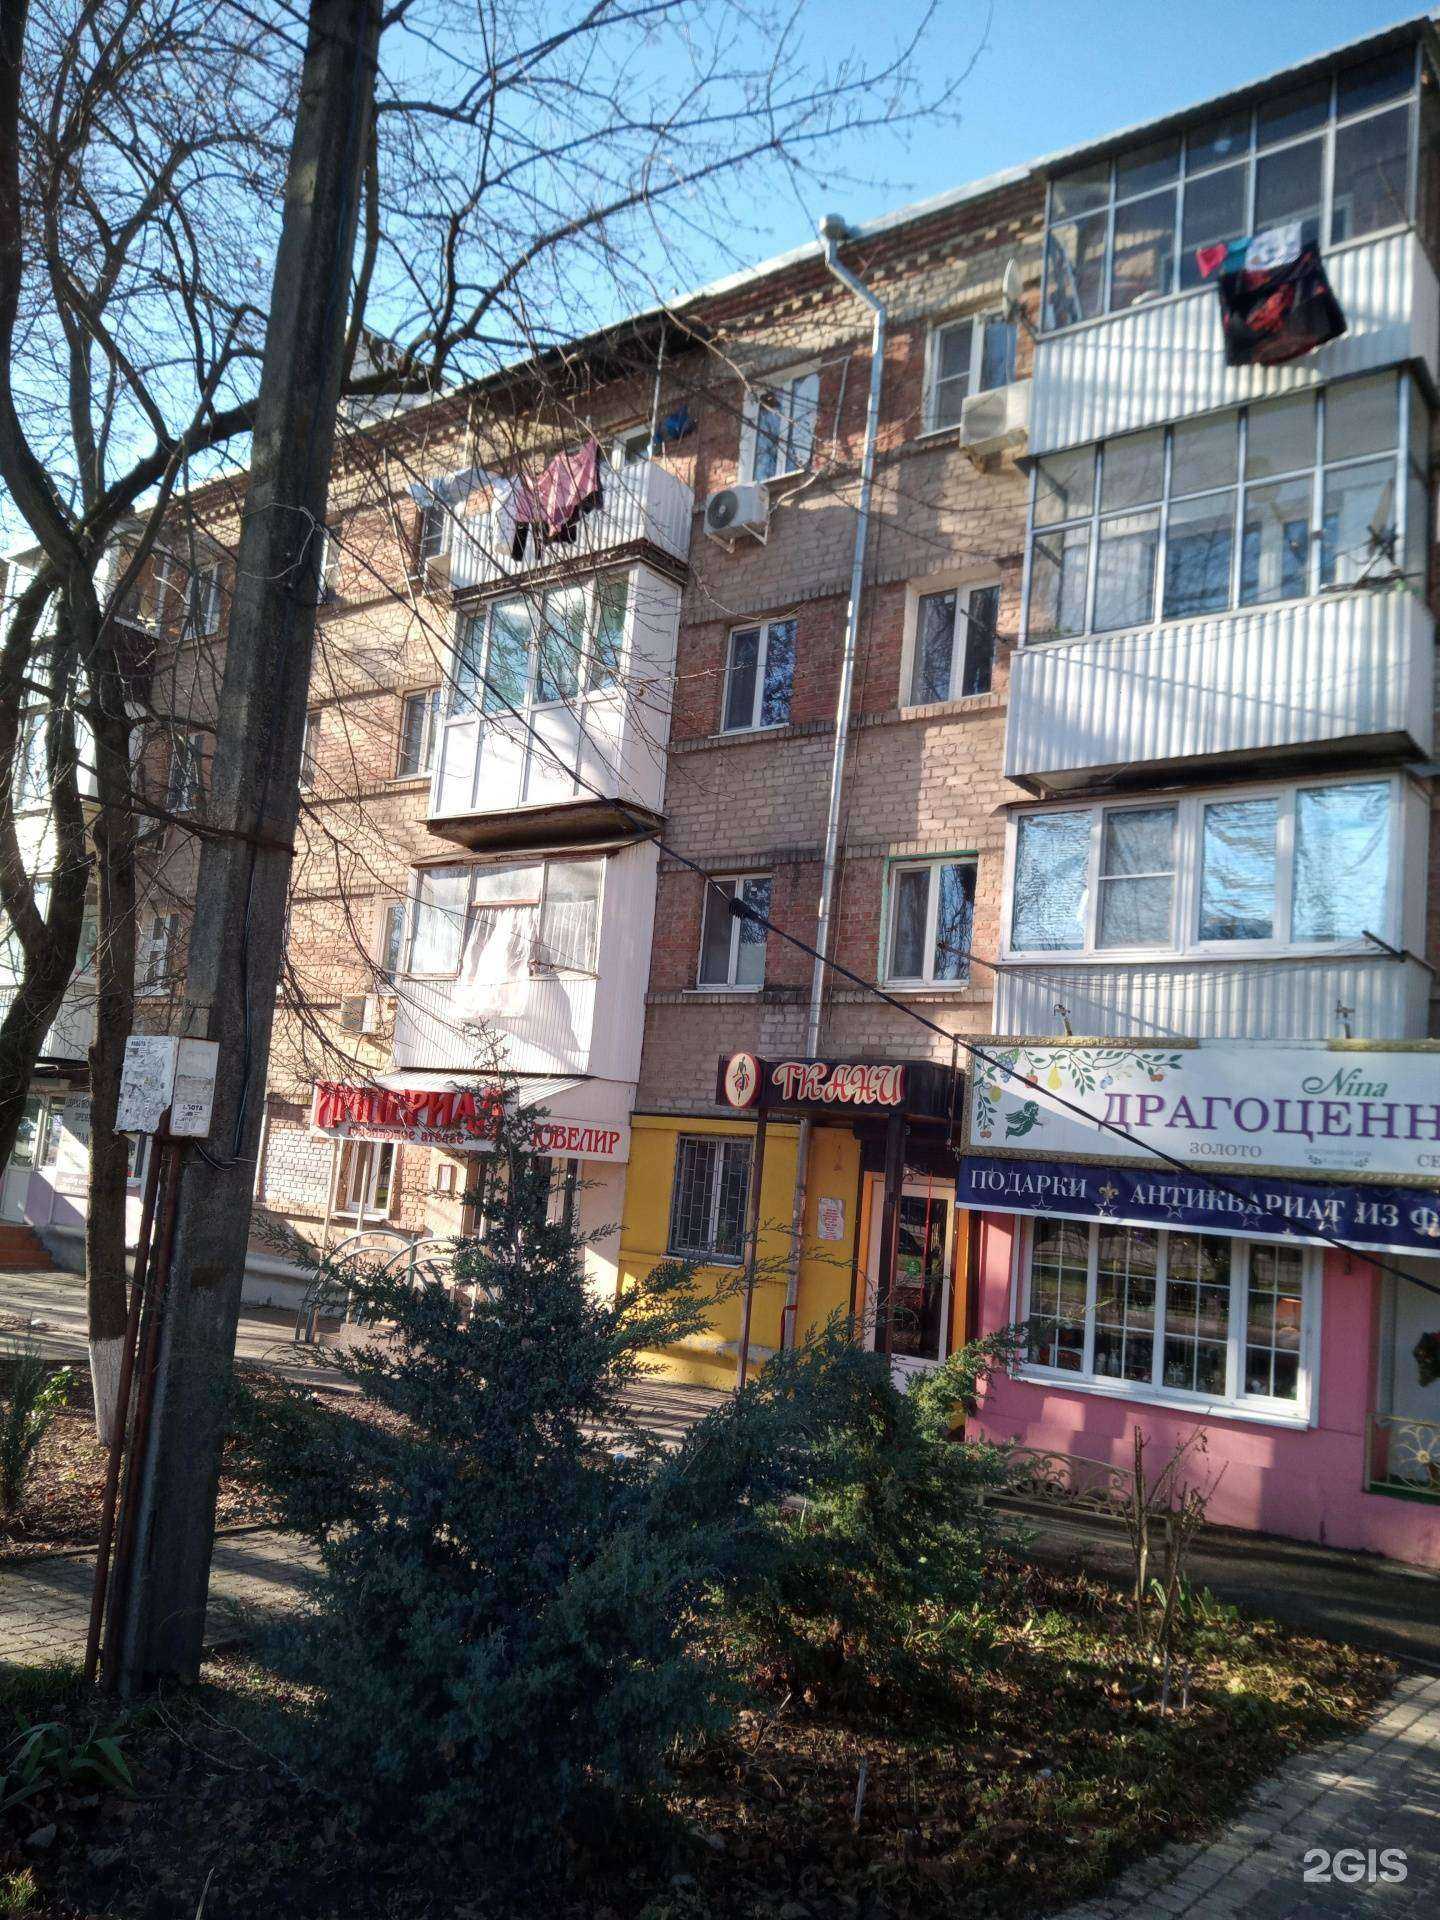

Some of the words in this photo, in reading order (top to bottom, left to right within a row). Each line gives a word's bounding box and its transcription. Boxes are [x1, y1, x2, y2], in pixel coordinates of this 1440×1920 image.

[772, 1062, 905, 1105] ТКАНИ
[1302, 1067, 1389, 1098] Nina
[532, 1121, 620, 1154] ЮВЕЛИР
[1189, 1141, 1262, 1159] ЗОЛОТО
[971, 1169, 1088, 1199] ПОДАРКИ
[1130, 1183, 1345, 1220] АНТИКВАРИАТ
[1356, 1202, 1399, 1228] ИЗ
